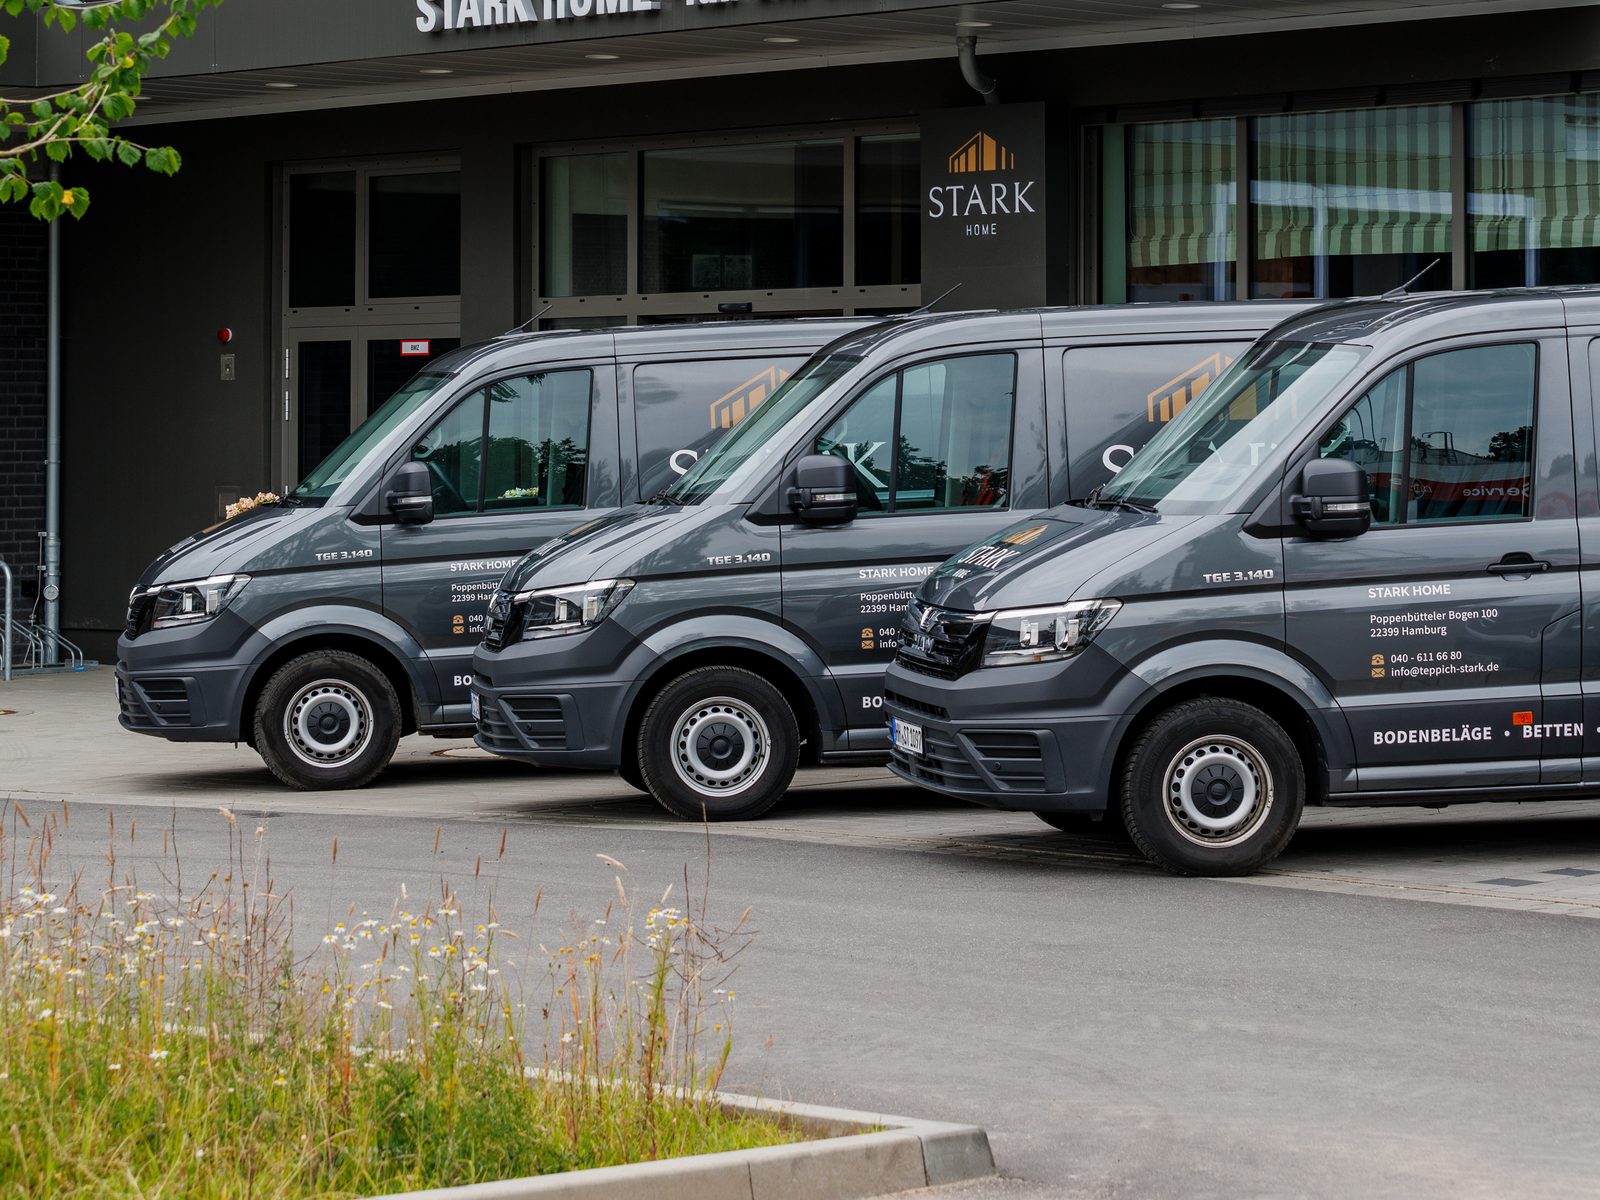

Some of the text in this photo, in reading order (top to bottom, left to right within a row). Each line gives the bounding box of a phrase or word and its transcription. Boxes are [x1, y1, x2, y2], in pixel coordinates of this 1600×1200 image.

[929, 181, 1036, 218] STARK
[966, 223, 997, 236] HOME
[315, 549, 373, 561] TGE 3.140
[707, 552, 771, 566] TGE 3.140
[450, 561, 484, 572] STARK
[859, 567, 897, 579] STARK
[1203, 569, 1274, 584] TGE 3.140
[451, 593, 476, 602] 22399
[860, 591, 916, 602] Poppenbütt
[1368, 583, 1451, 599] STARK HOME
[860, 604, 887, 614] 22399
[468, 614, 484, 623] 040
[1370, 608, 1498, 624] Poppenbütteler Bogen 100
[879, 627, 896, 636] 040
[1370, 624, 1448, 637] 22399 Hamburg
[1390, 653, 1409, 663] 040
[1416, 652, 1434, 662] 611
[1435, 651, 1449, 661] 66
[1450, 650, 1462, 660] 80
[1391, 662, 1499, 677] info@teppich-stark.de
[1373, 722, 1584, 745] BODENBELÄGE BETTEN
